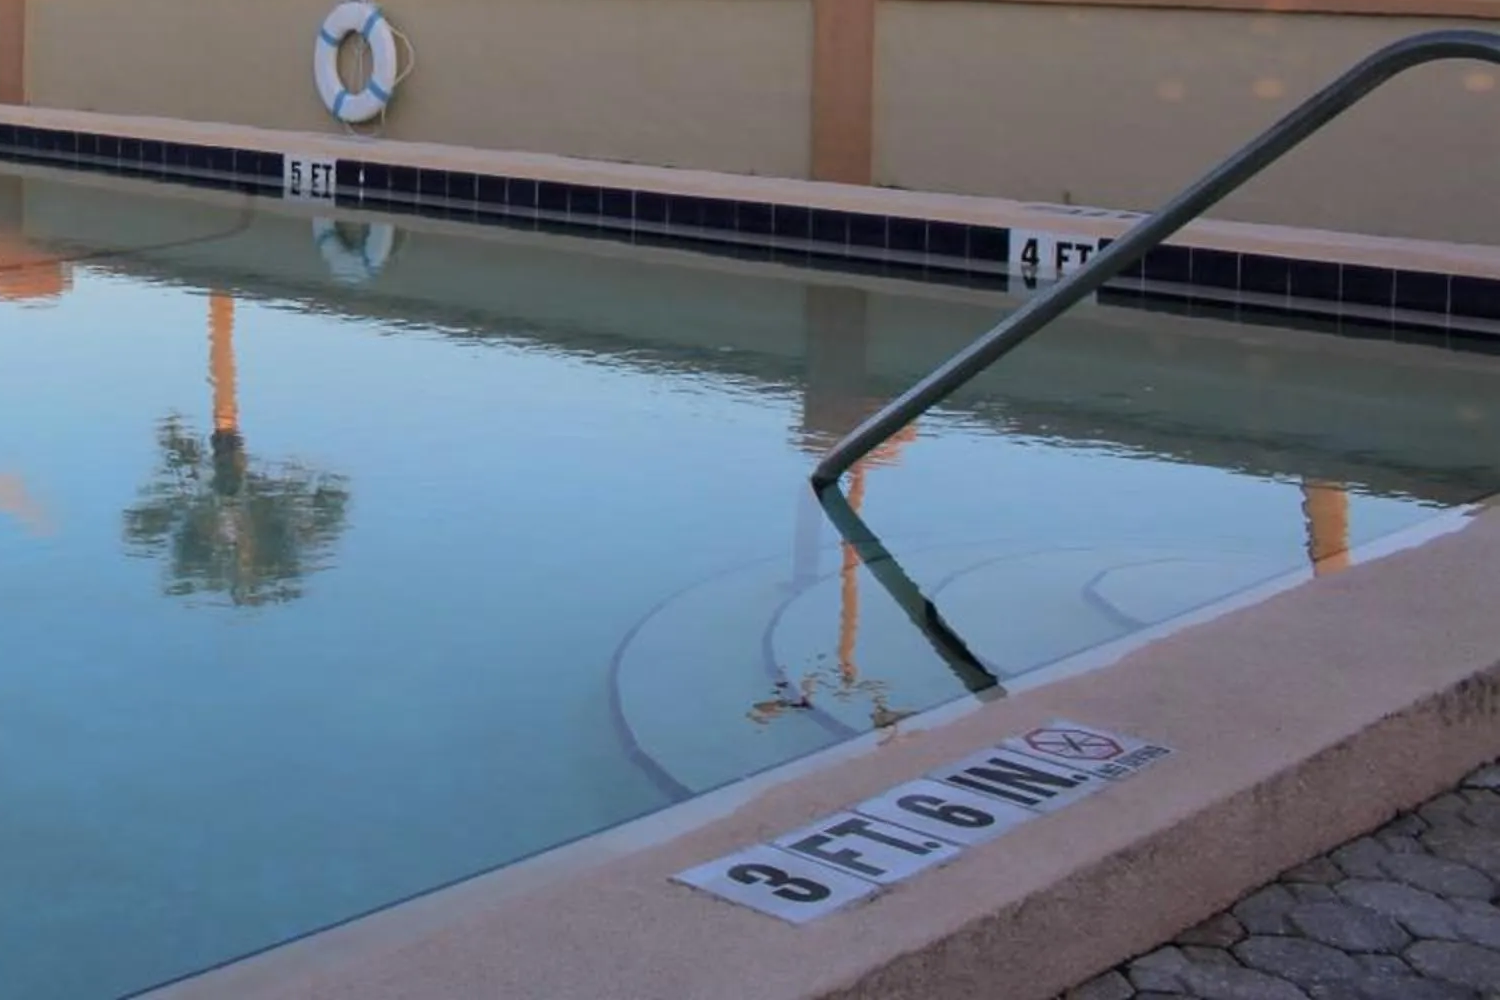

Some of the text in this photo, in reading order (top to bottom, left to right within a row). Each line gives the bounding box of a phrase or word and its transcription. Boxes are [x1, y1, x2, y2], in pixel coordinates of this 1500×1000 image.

[291, 161, 301, 184] 5
[1021, 238, 1094, 271] 4 FT
[945, 757, 1089, 806] IN.
[896, 794, 996, 828] 6
[788, 817, 942, 877] FT.
[727, 863, 831, 903] 3
